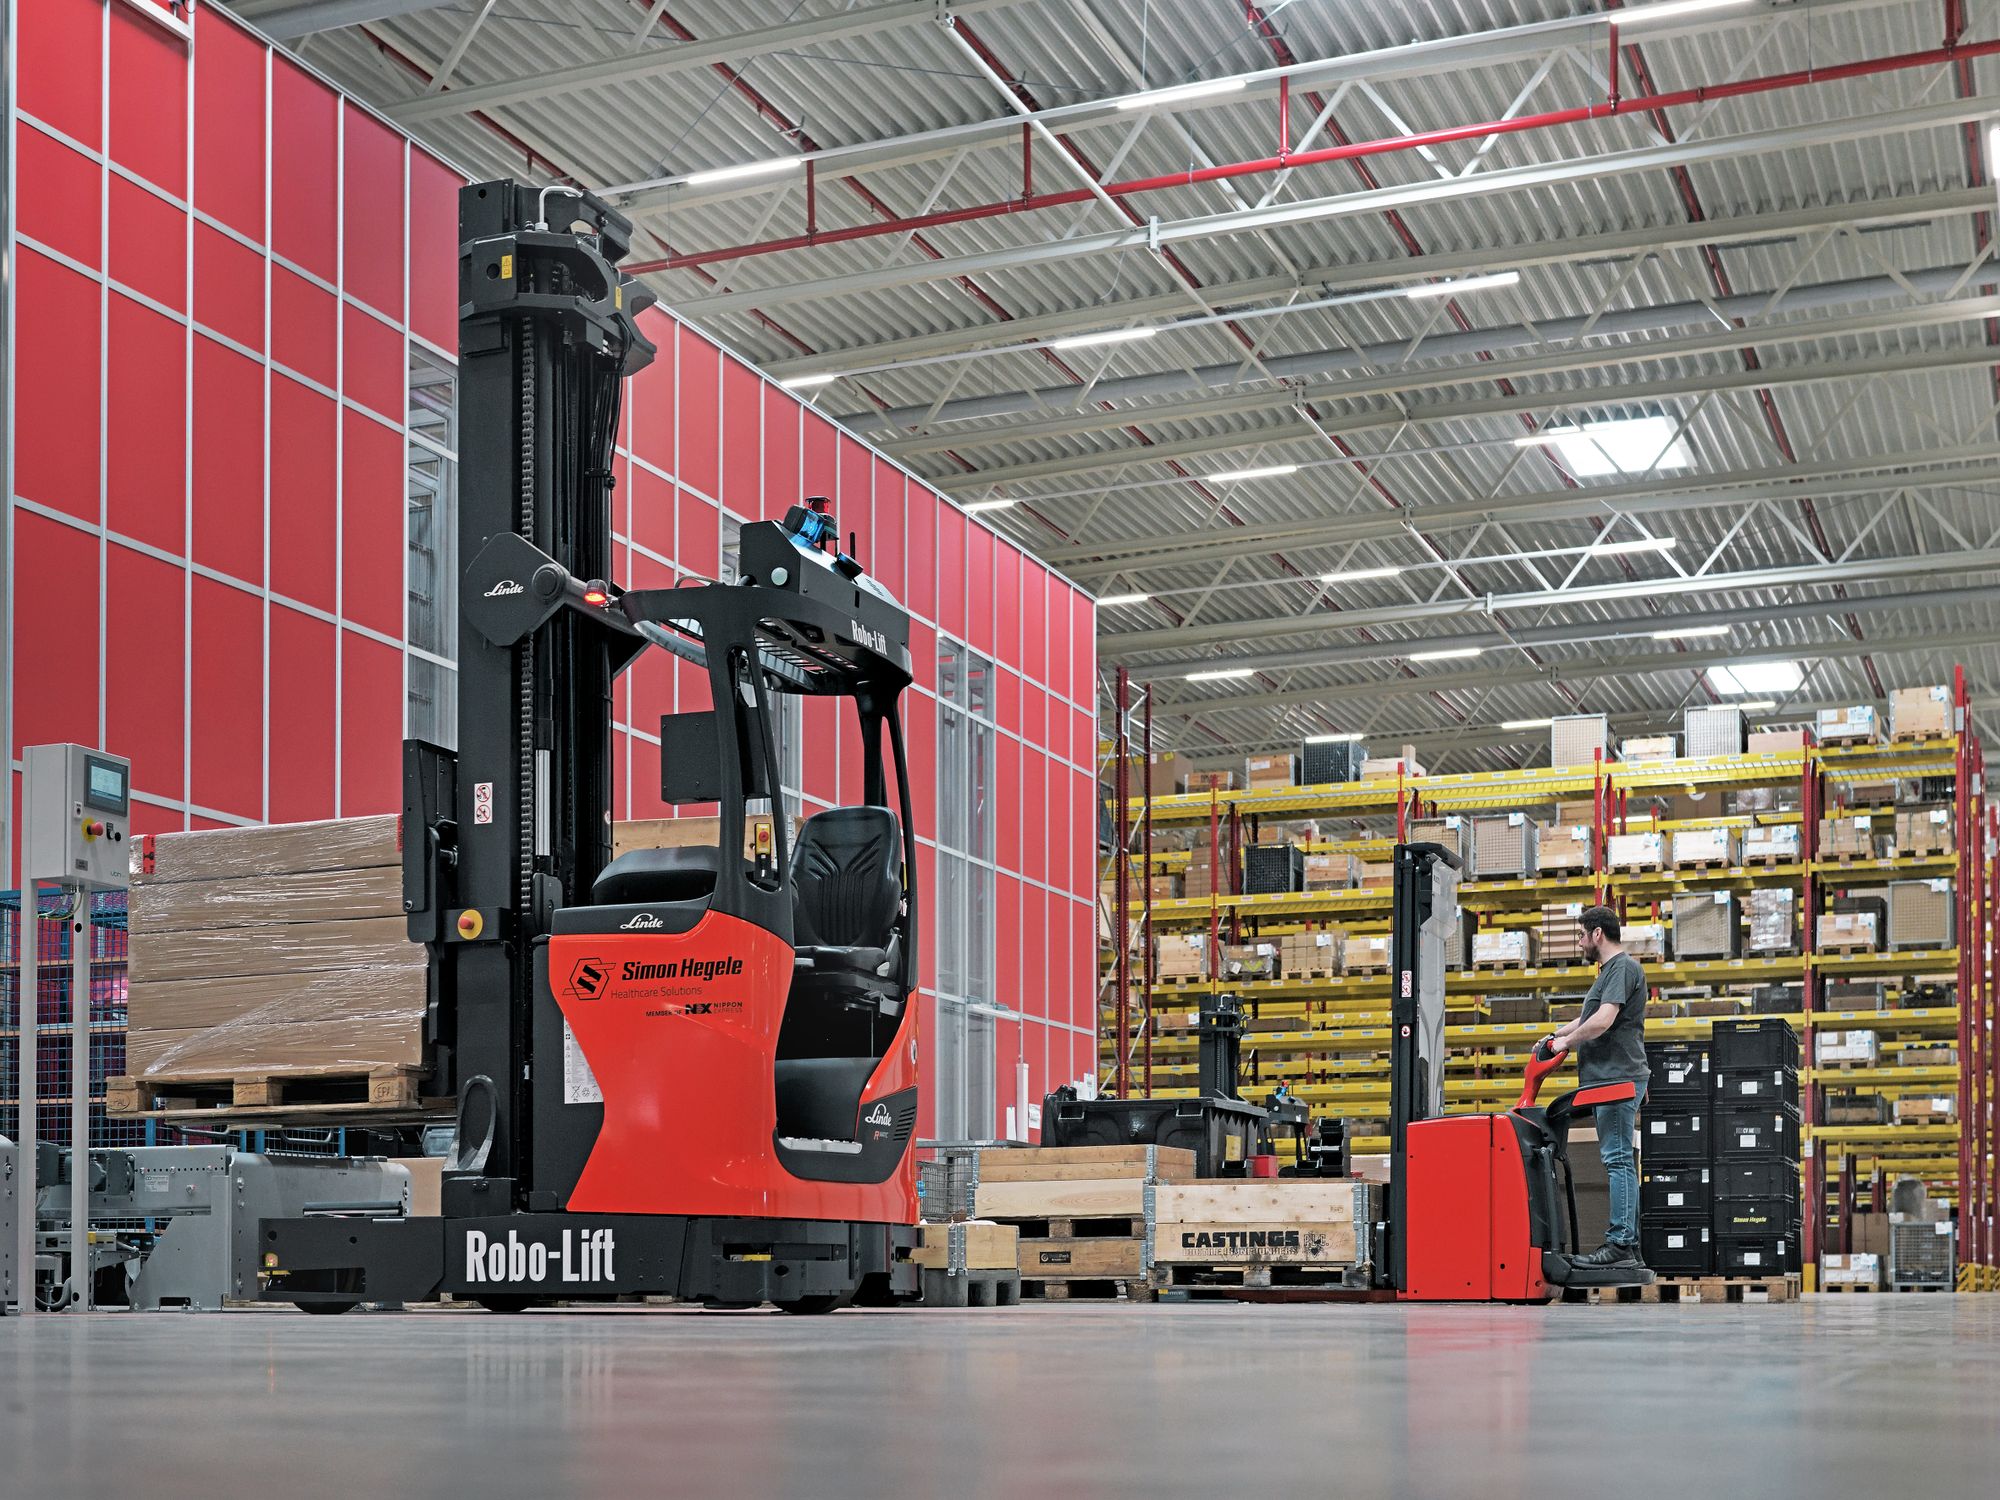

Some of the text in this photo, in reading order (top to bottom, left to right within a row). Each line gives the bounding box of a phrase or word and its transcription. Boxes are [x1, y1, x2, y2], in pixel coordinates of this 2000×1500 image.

[484, 580, 524, 597] Linde
[851, 619, 888, 656] Robo-Lift
[620, 913, 663, 929] Linde
[622, 956, 743, 981] Simon Hegele
[610, 986, 703, 999] Healthcare Solutions
[865, 1103, 892, 1126] Linde
[1181, 1231, 1299, 1248] CASTINGS
[466, 1228, 616, 1282] Robo-Lift
